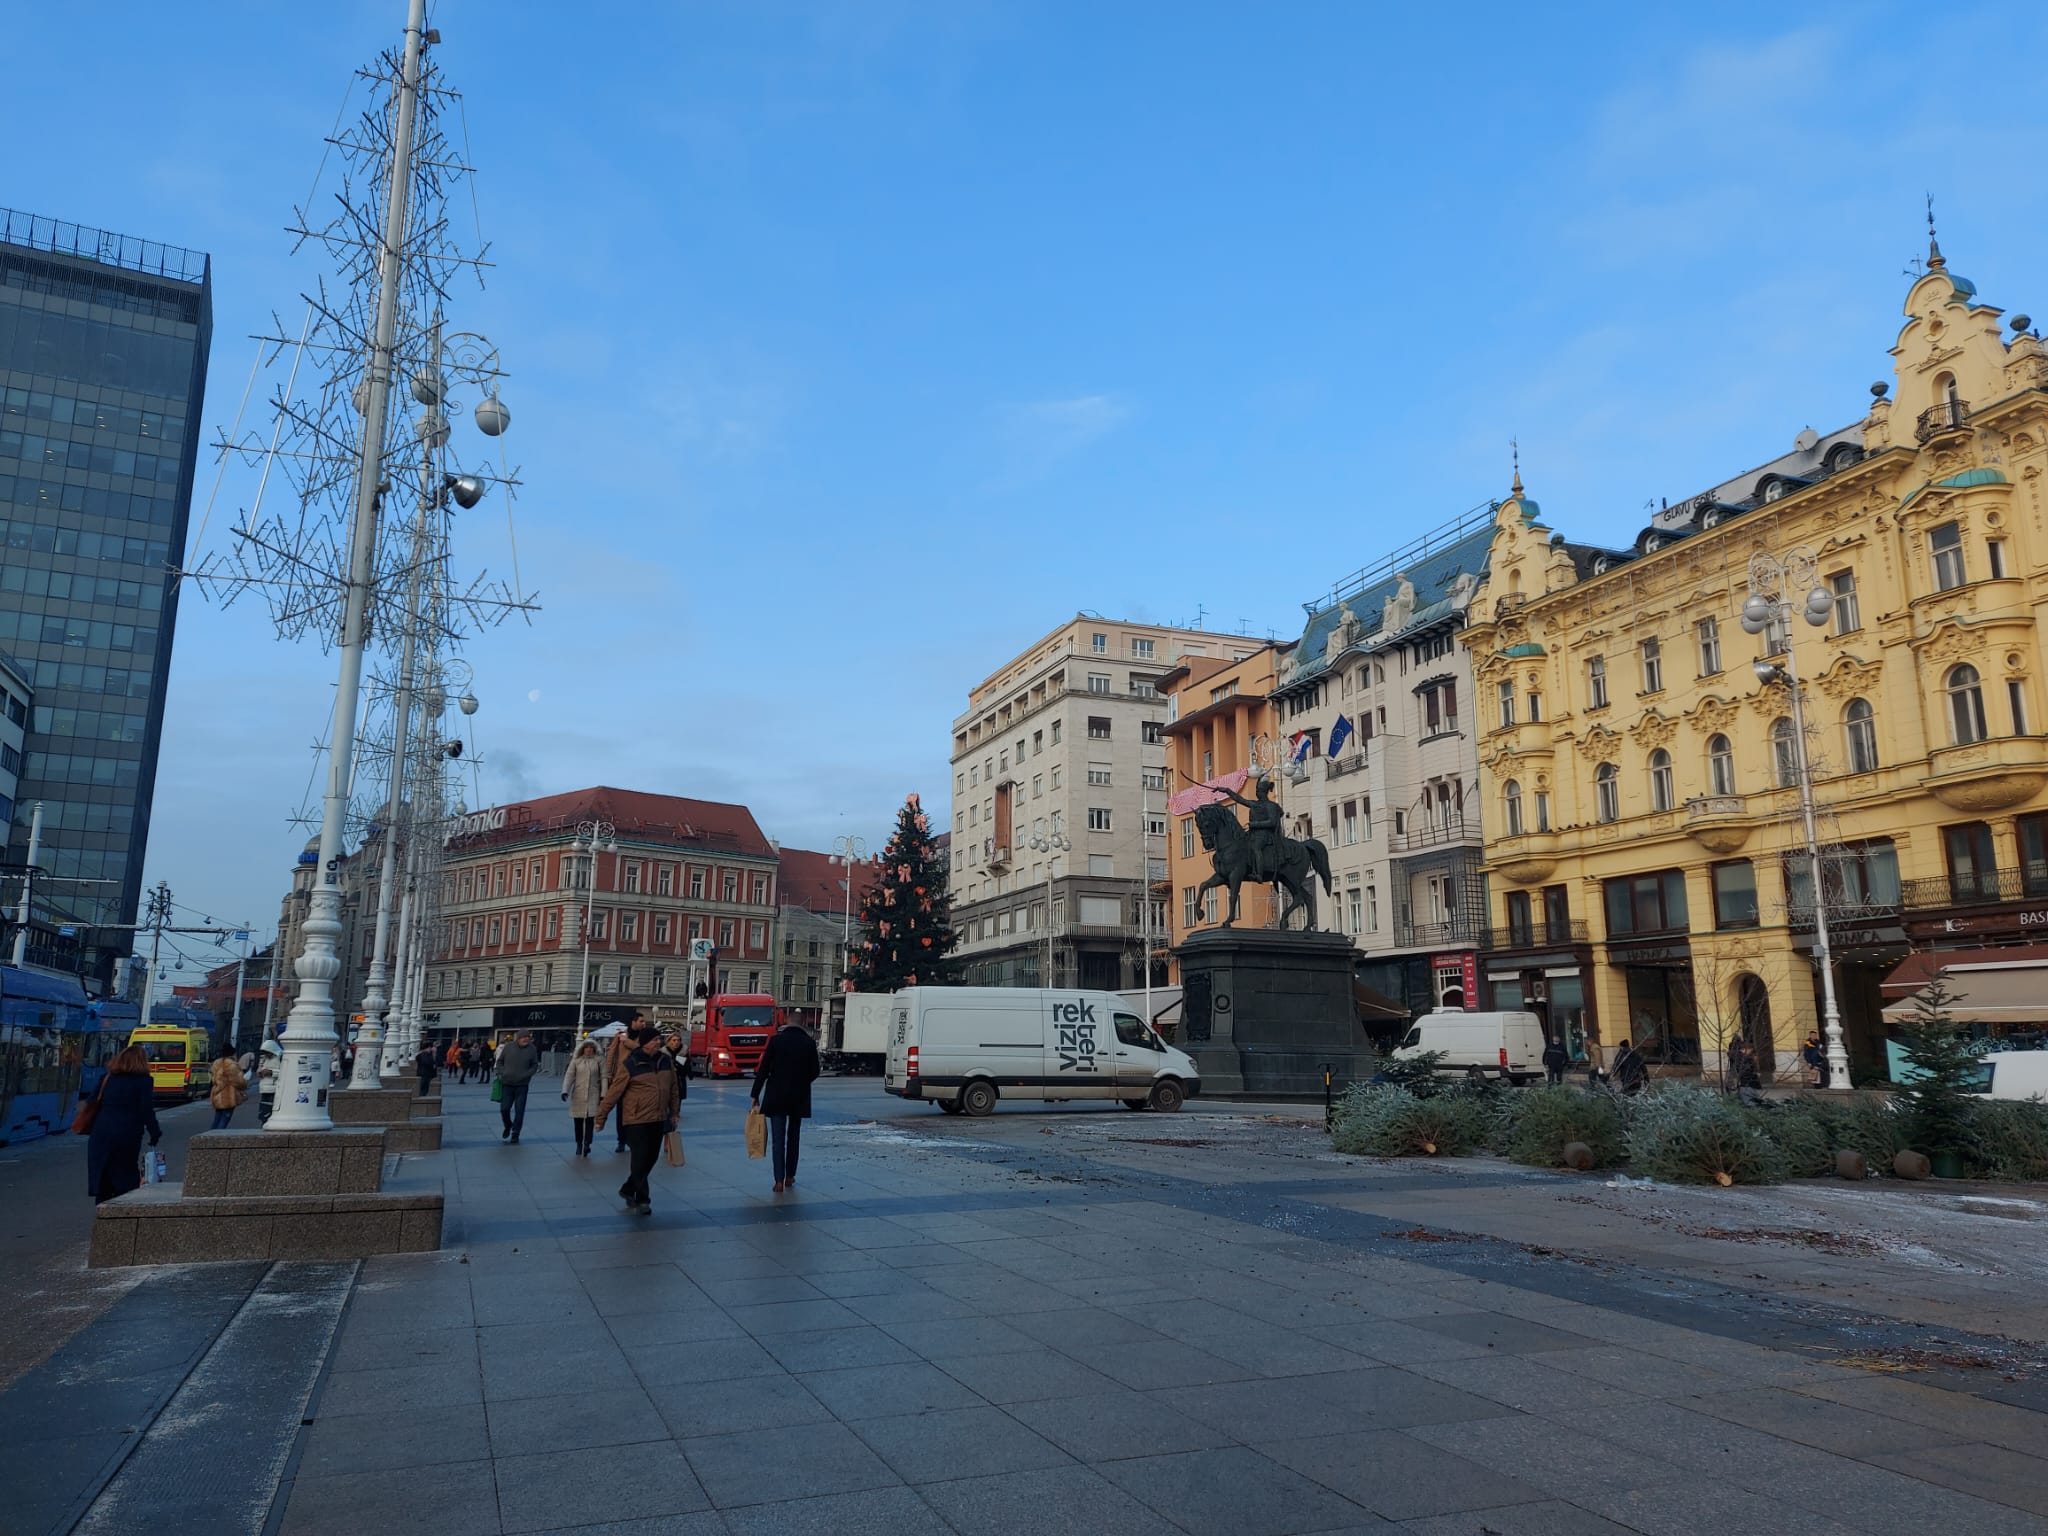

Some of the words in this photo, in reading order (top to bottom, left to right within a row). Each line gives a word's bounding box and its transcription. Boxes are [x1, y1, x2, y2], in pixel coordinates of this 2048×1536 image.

[1663, 502, 1690, 522] GLAVU
[1828, 930, 1881, 946] ARMICA
[1053, 998, 1096, 1023] rek
